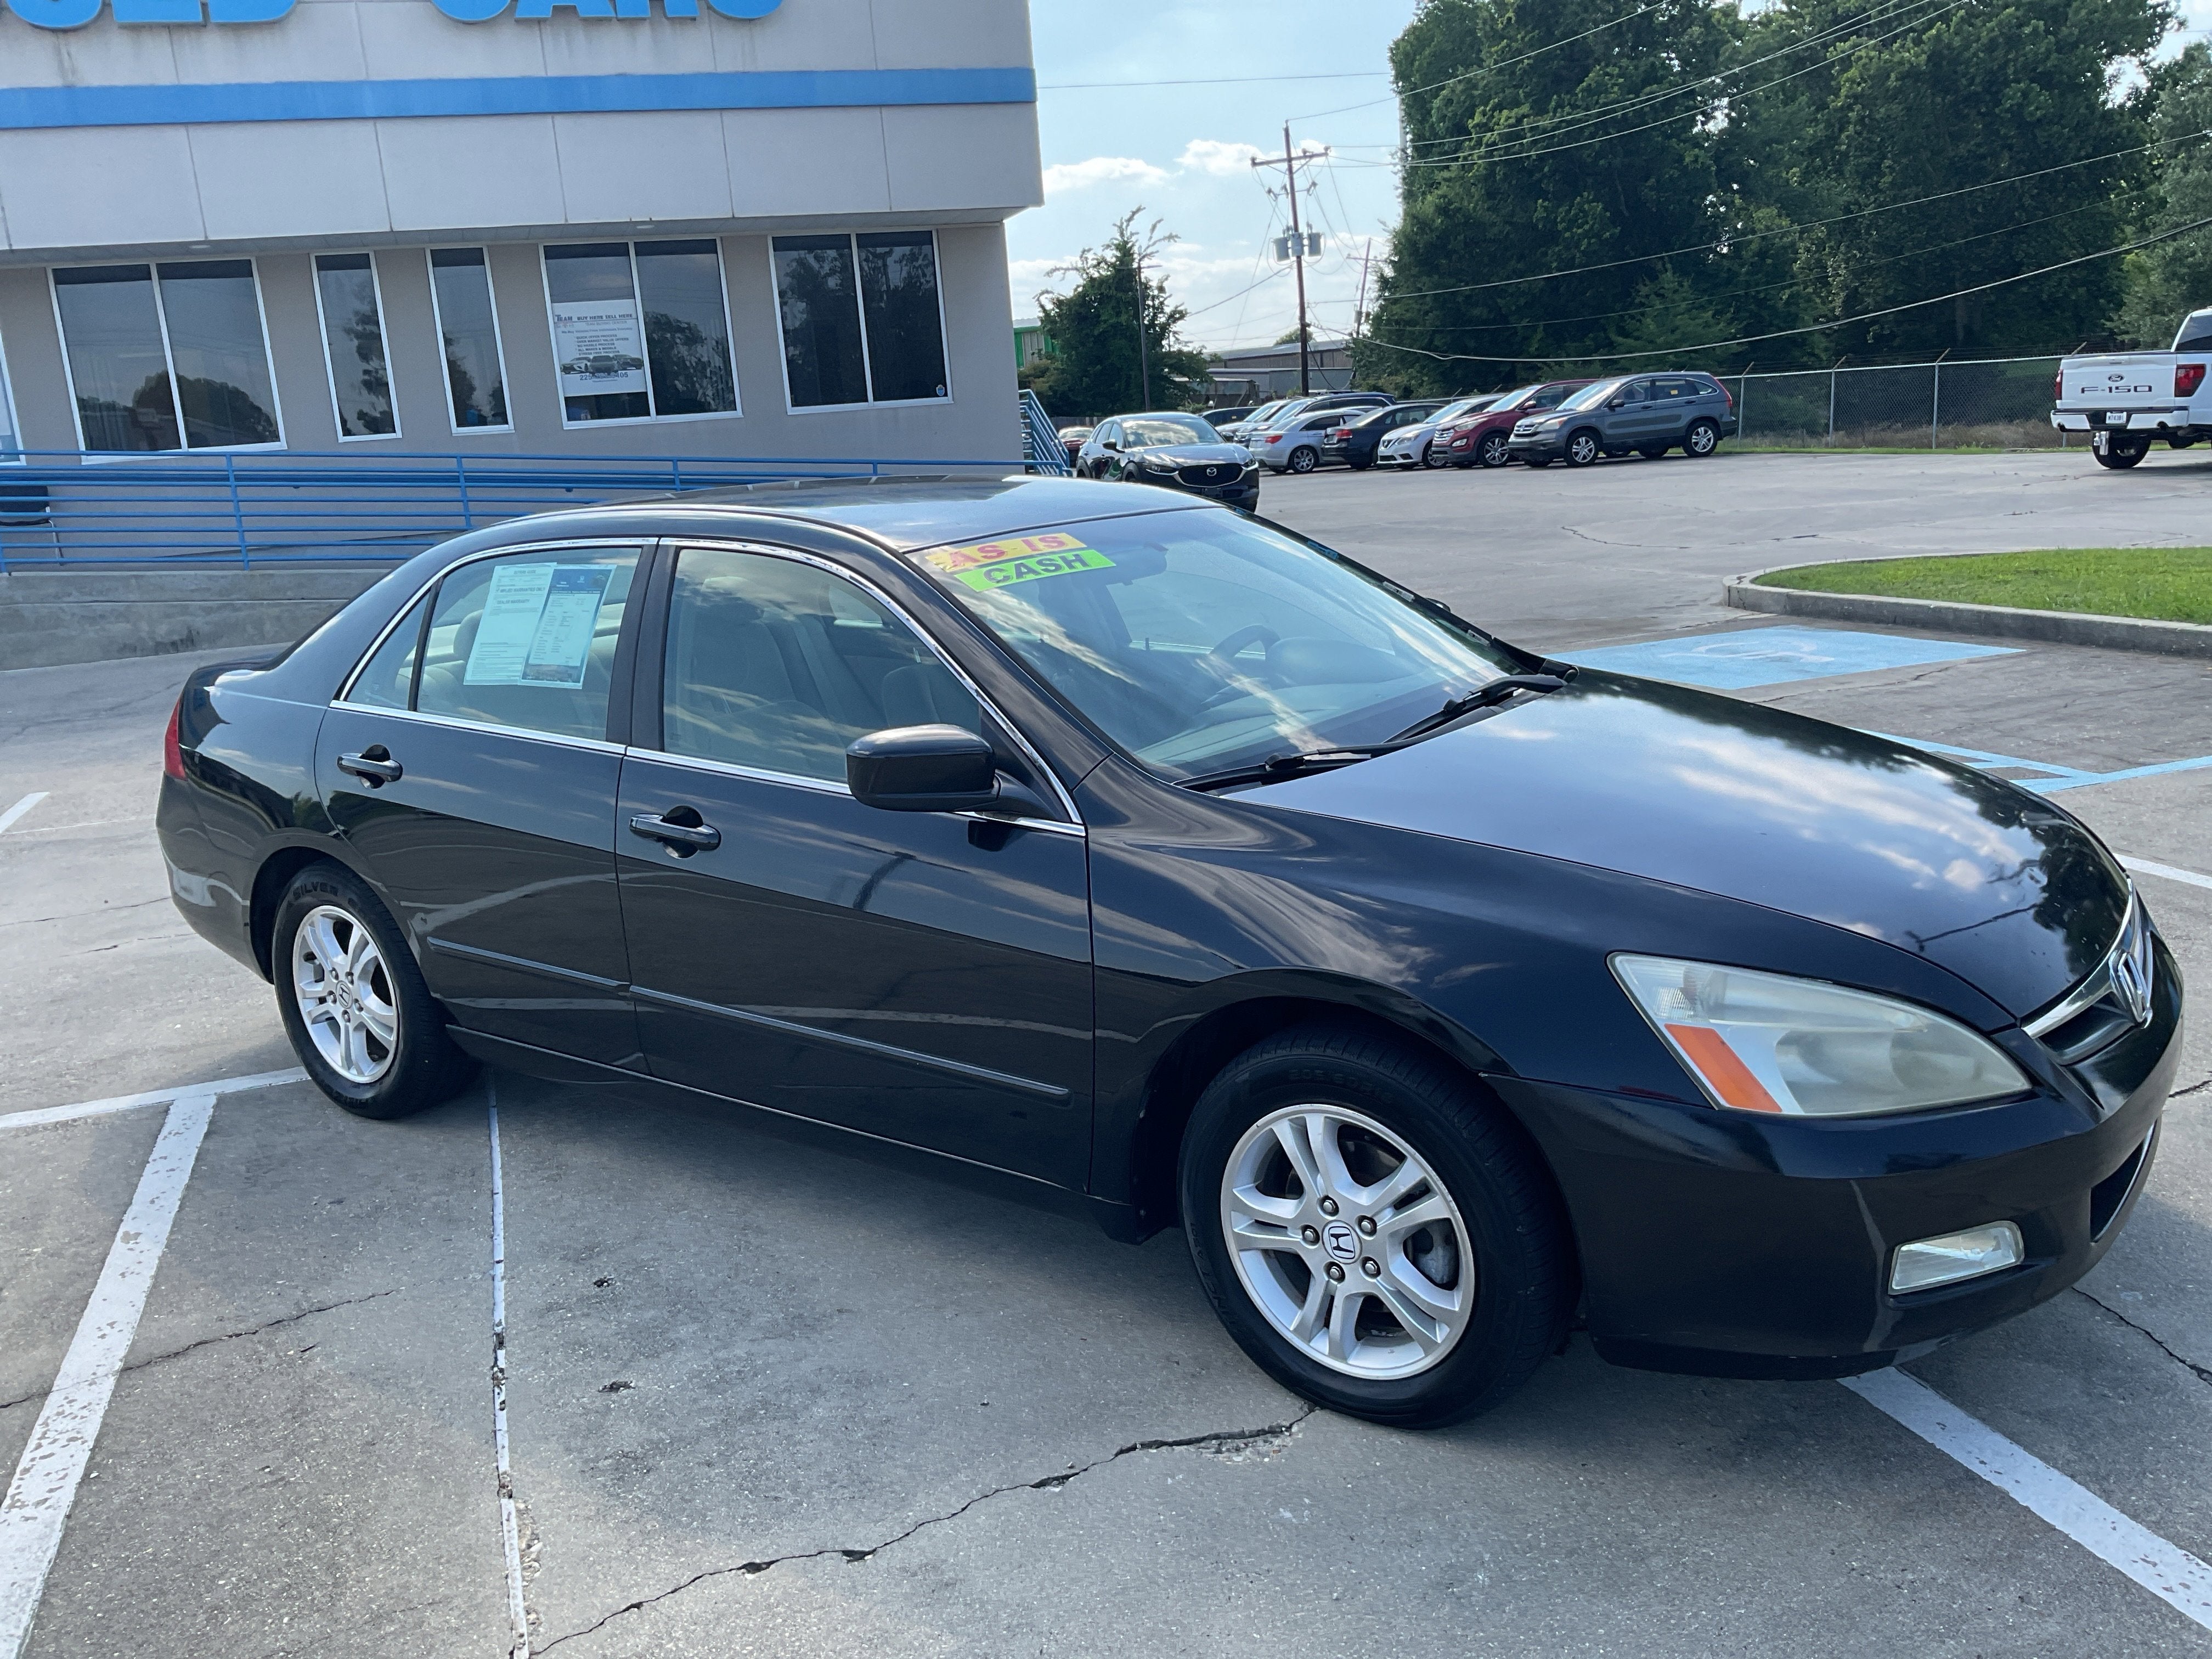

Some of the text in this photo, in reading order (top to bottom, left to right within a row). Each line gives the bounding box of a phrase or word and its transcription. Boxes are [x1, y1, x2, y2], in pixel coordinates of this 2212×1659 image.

[2081, 385, 2152, 394] F-150
[1020, 535, 1066, 552] IS
[983, 554, 1090, 584] CASH
